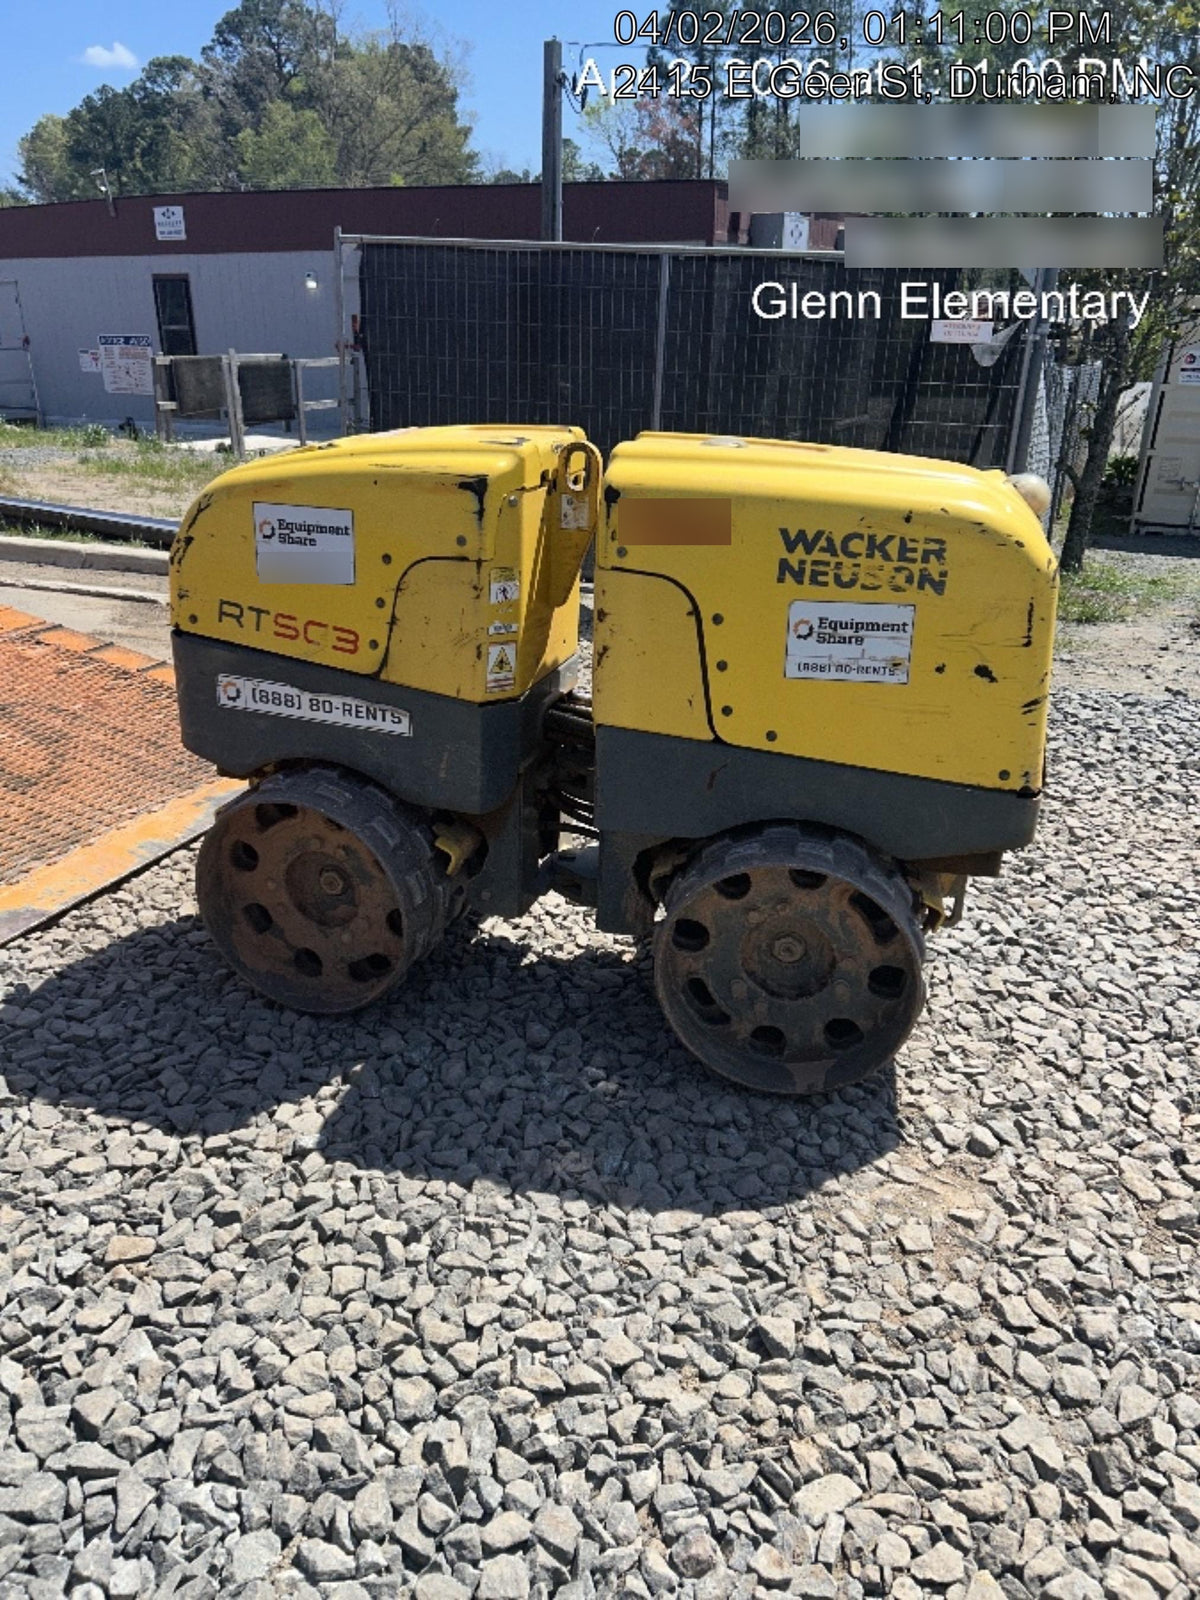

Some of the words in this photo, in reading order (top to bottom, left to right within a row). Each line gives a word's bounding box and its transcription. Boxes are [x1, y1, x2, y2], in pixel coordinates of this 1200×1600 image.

[277, 519, 351, 537] Equipment
[278, 532, 318, 547] Share
[778, 527, 947, 566] WACKER
[776, 557, 949, 597] NEUSON
[218, 599, 360, 655] RTSC3
[817, 616, 910, 634] Equipment
[815, 632, 865, 647] Share
[251, 687, 302, 711] (888)
[308, 697, 403, 726] 80-RENTS
